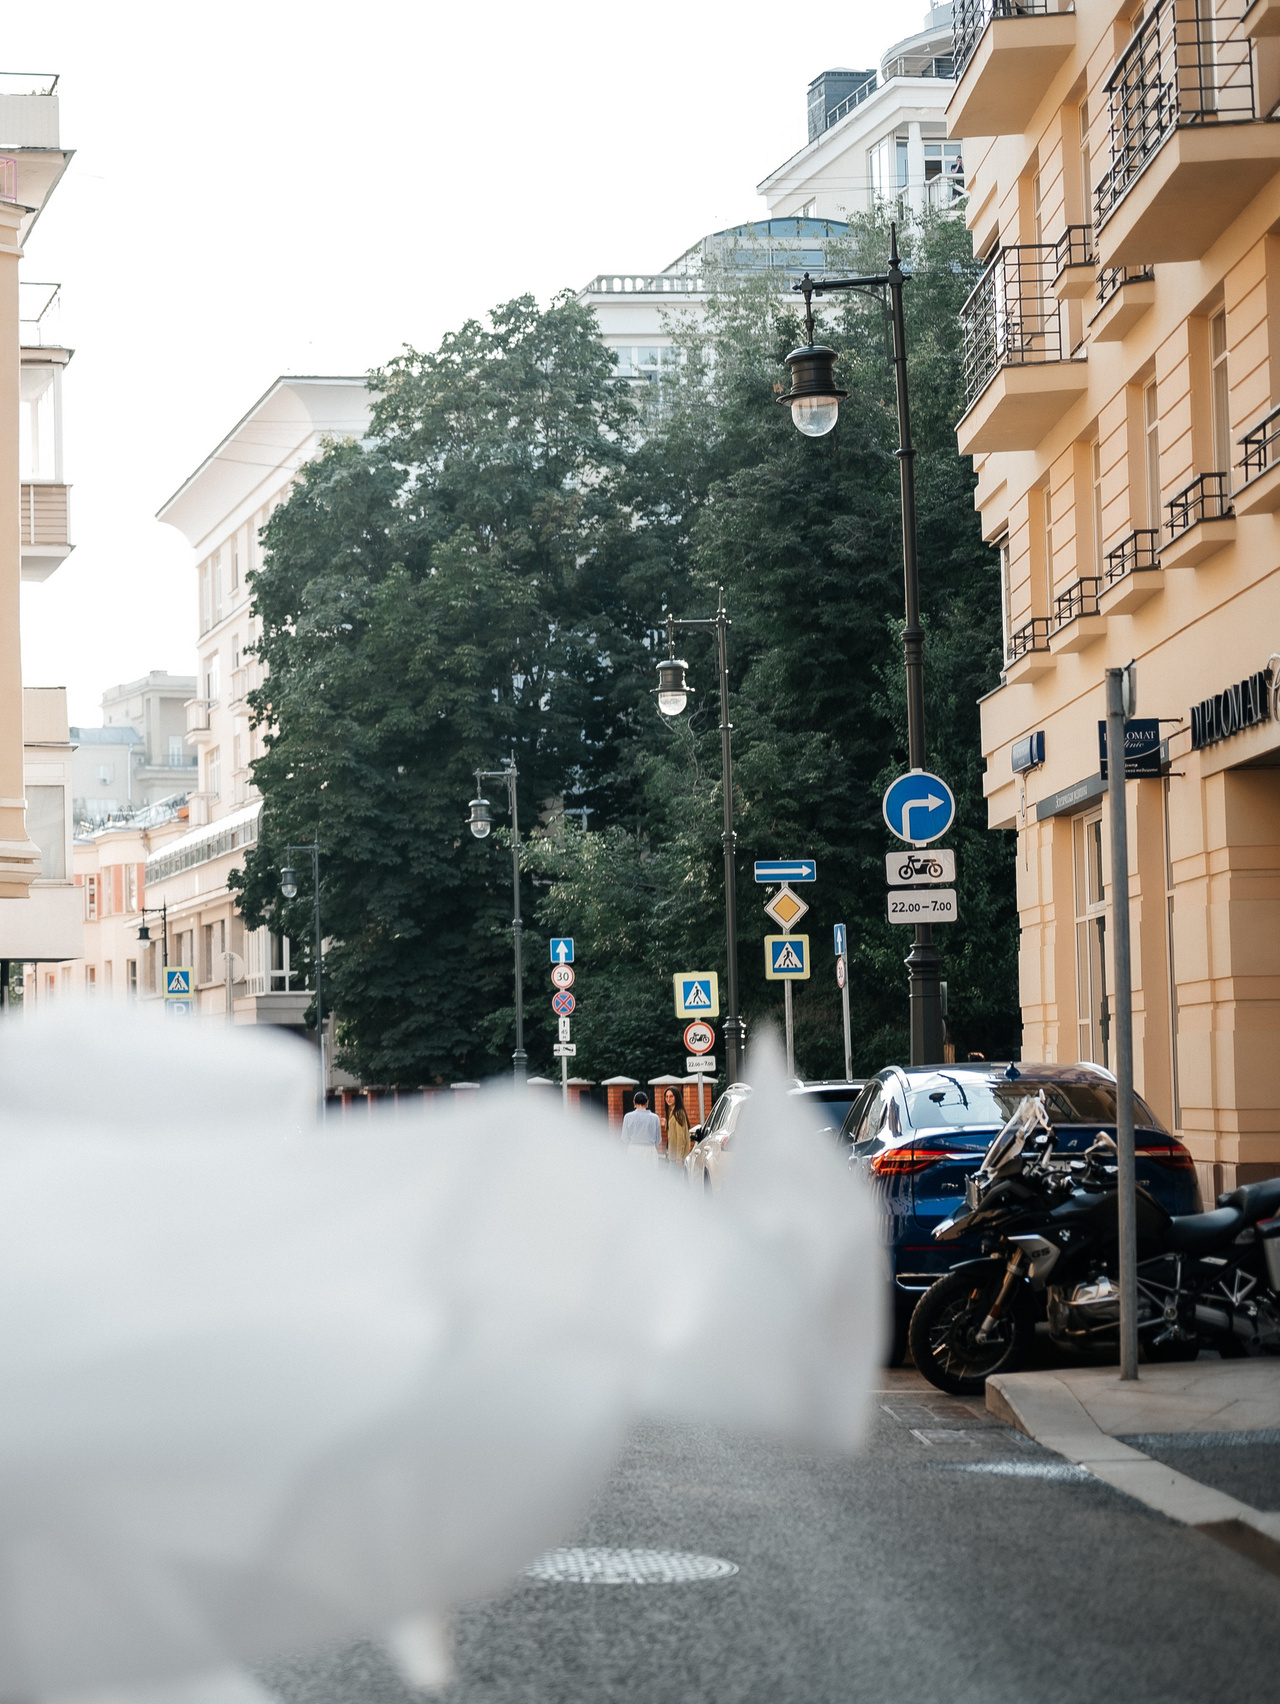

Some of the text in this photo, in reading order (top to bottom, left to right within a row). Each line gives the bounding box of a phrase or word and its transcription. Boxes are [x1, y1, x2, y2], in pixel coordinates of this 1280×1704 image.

[1189, 671, 1269, 750] DIPLOMAT
[557, 972, 569, 981] 30
[1031, 1246, 1051, 1258] GS
